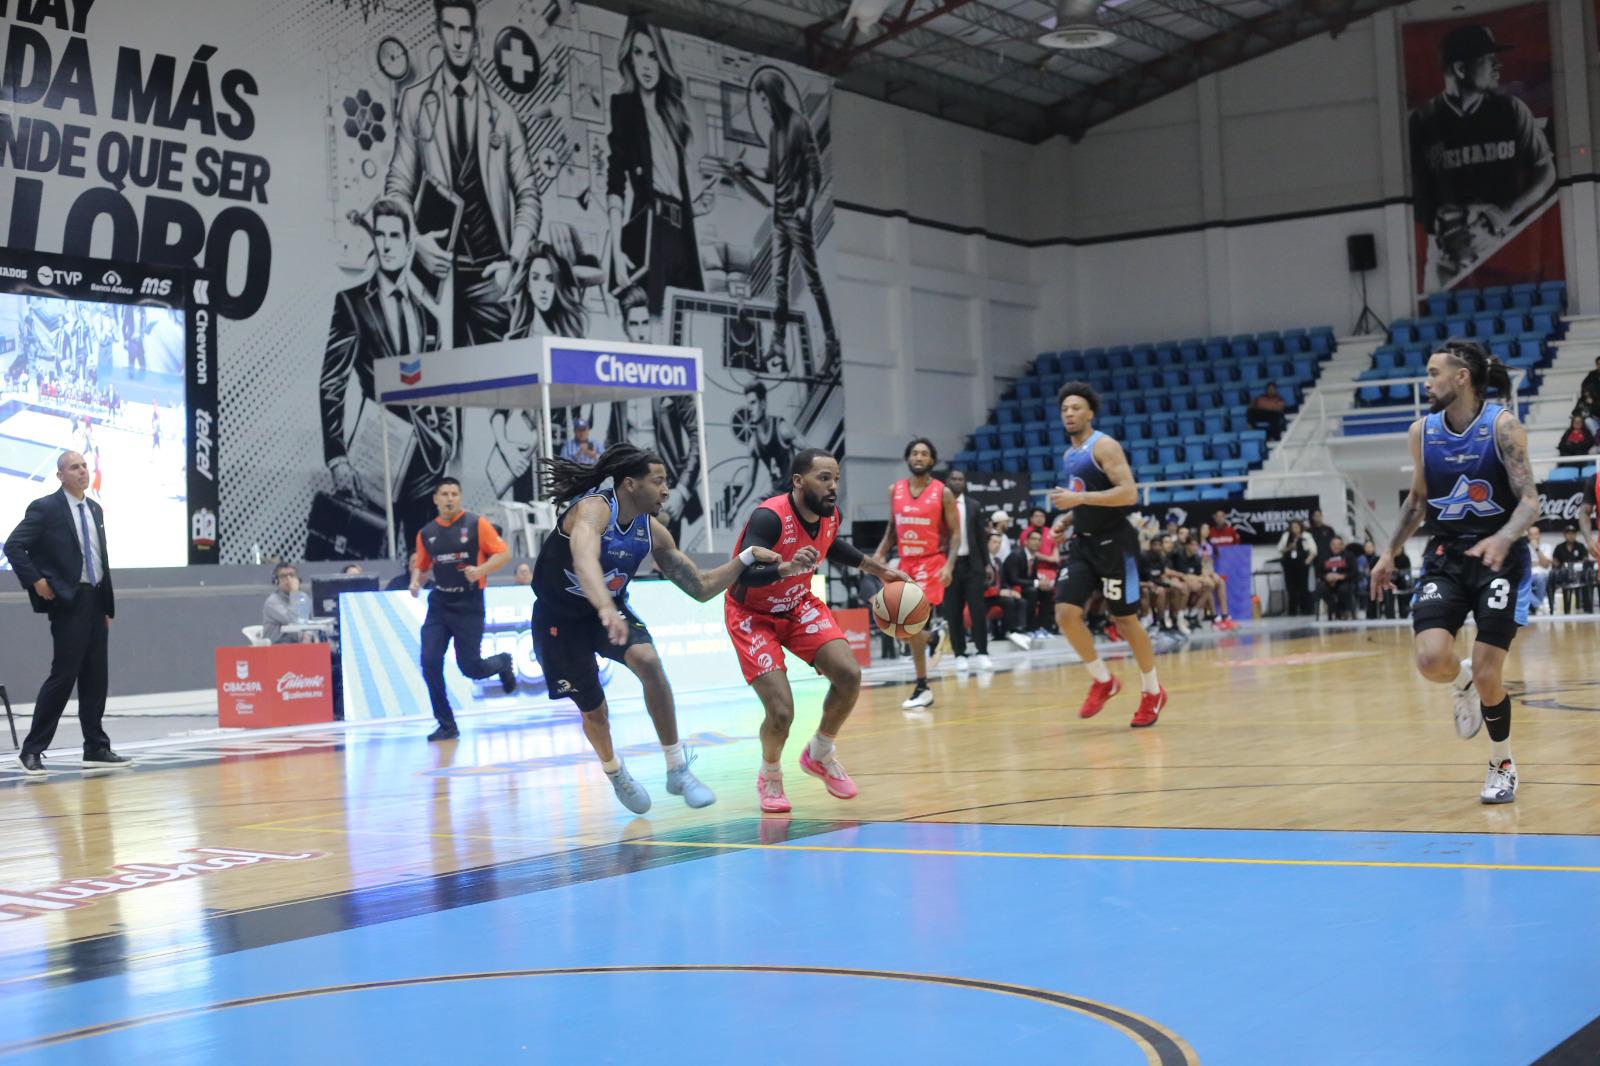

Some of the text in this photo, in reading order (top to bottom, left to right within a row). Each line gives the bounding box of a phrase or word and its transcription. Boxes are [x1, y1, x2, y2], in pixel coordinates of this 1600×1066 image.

[111, 44, 259, 141] MÁS
[97, 131, 187, 193] QUE
[193, 147, 271, 204] SER
[54, 271, 83, 286] TVP
[195, 309, 208, 385] Chevron
[594, 354, 687, 386] Chevron
[1250, 510, 1310, 523] AMERICAN
[1487, 578, 1511, 610] 3
